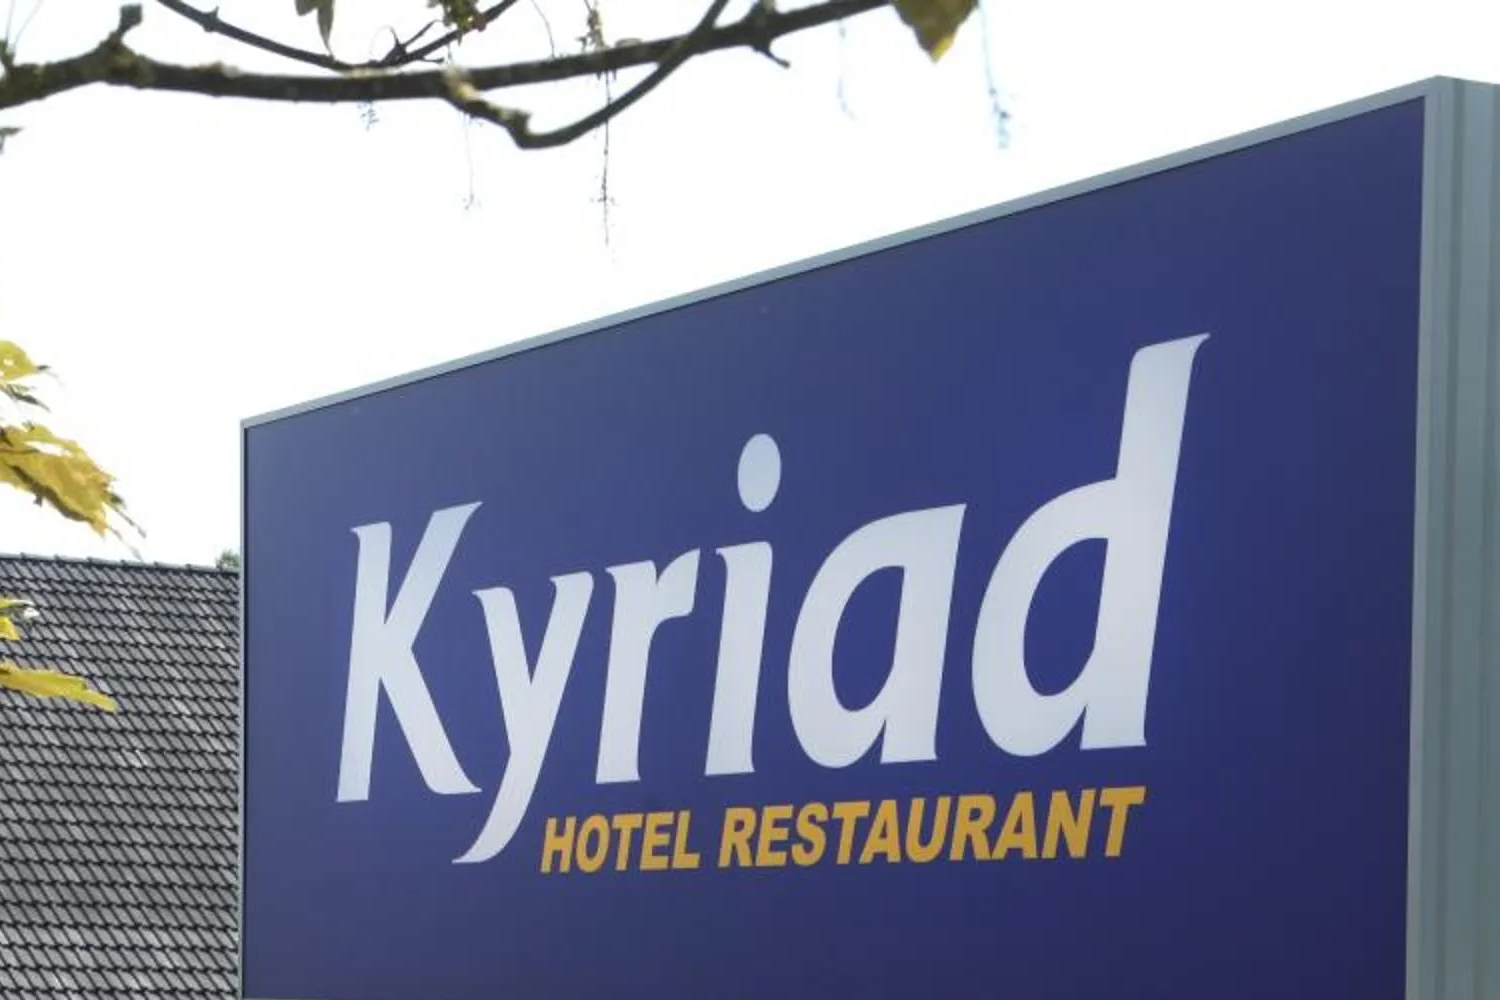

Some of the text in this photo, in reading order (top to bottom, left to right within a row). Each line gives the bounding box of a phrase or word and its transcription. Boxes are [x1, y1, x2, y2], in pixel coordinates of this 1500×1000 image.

[337, 334, 1209, 863] Kyriad
[540, 786, 1147, 873] HOTEL RESTAURANT
